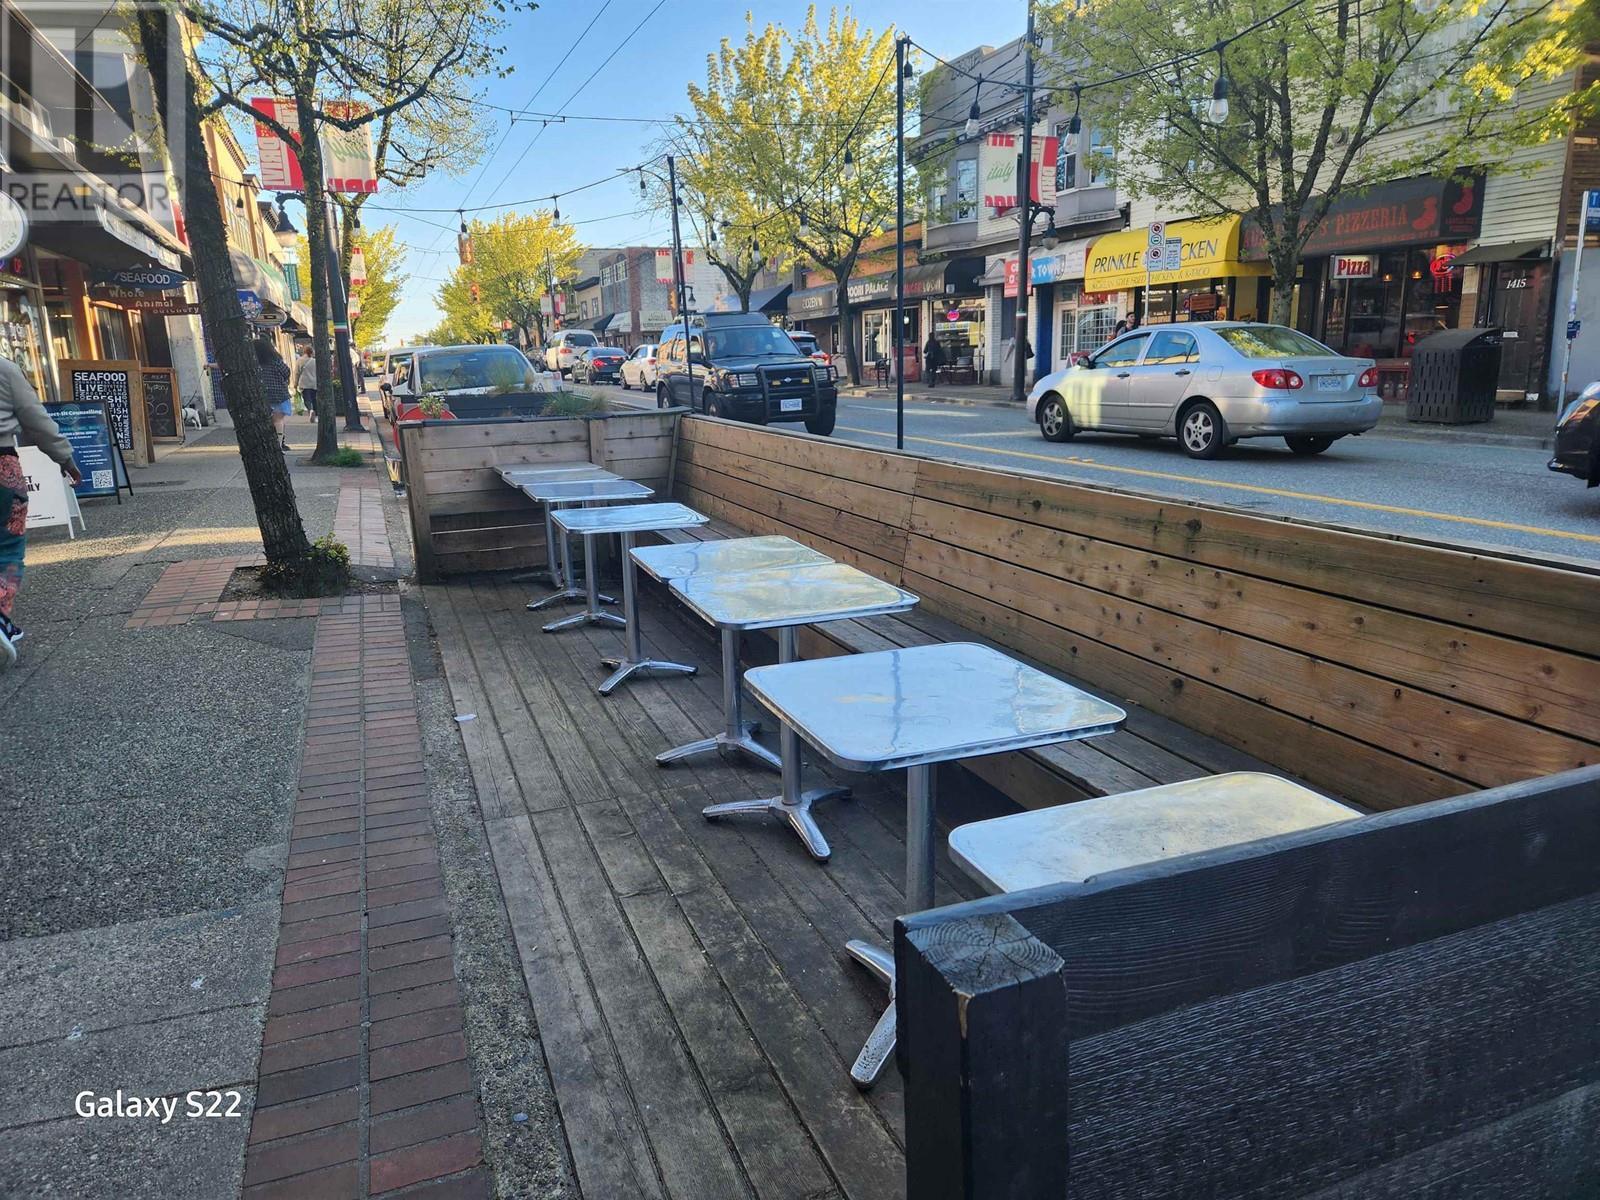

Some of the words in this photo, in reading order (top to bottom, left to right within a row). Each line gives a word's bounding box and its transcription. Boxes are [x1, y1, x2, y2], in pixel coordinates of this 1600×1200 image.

[1336, 203, 1408, 236] PIZZERIA
[1092, 251, 1140, 273] PRINKLE
[1180, 238, 1218, 262] CKEN
[1337, 258, 1371, 275] Pizza
[120, 272, 171, 285] SEAFOOD
[1506, 278, 1527, 289] 1415
[109, 286, 145, 298] Whole
[865, 280, 889, 295] PALACE
[135, 300, 174, 308] Animal
[74, 372, 126, 382] SEAFOOD
[79, 384, 104, 392] LIVE
